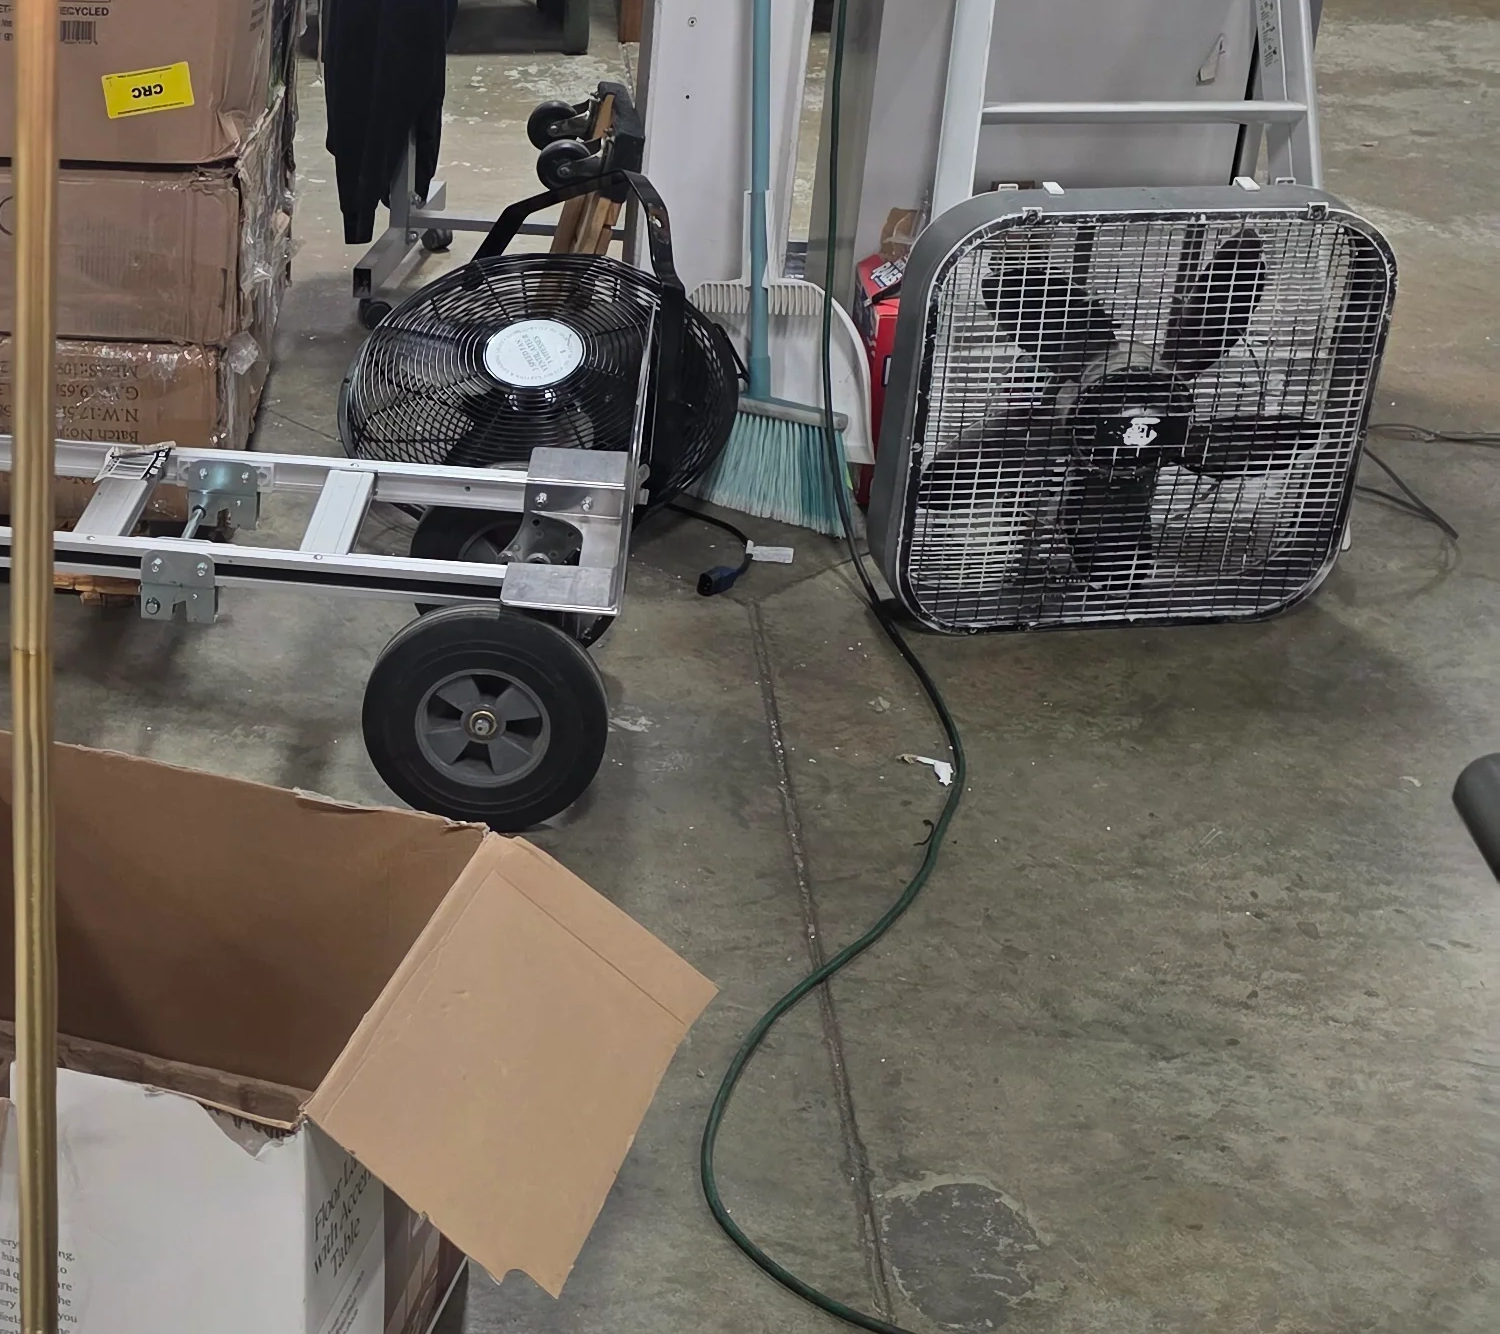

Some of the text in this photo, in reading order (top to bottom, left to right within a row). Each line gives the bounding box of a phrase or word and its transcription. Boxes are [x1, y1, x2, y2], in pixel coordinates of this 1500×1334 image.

[131, 83, 164, 99] CRC
[108, 428, 139, 443] Batch
[314, 1187, 343, 1243] Floor
[314, 1166, 373, 1274] with Accen
[332, 1217, 361, 1278] Table
[1, 1252, 20, 1264] has
[57, 1314, 77, 1325] you
